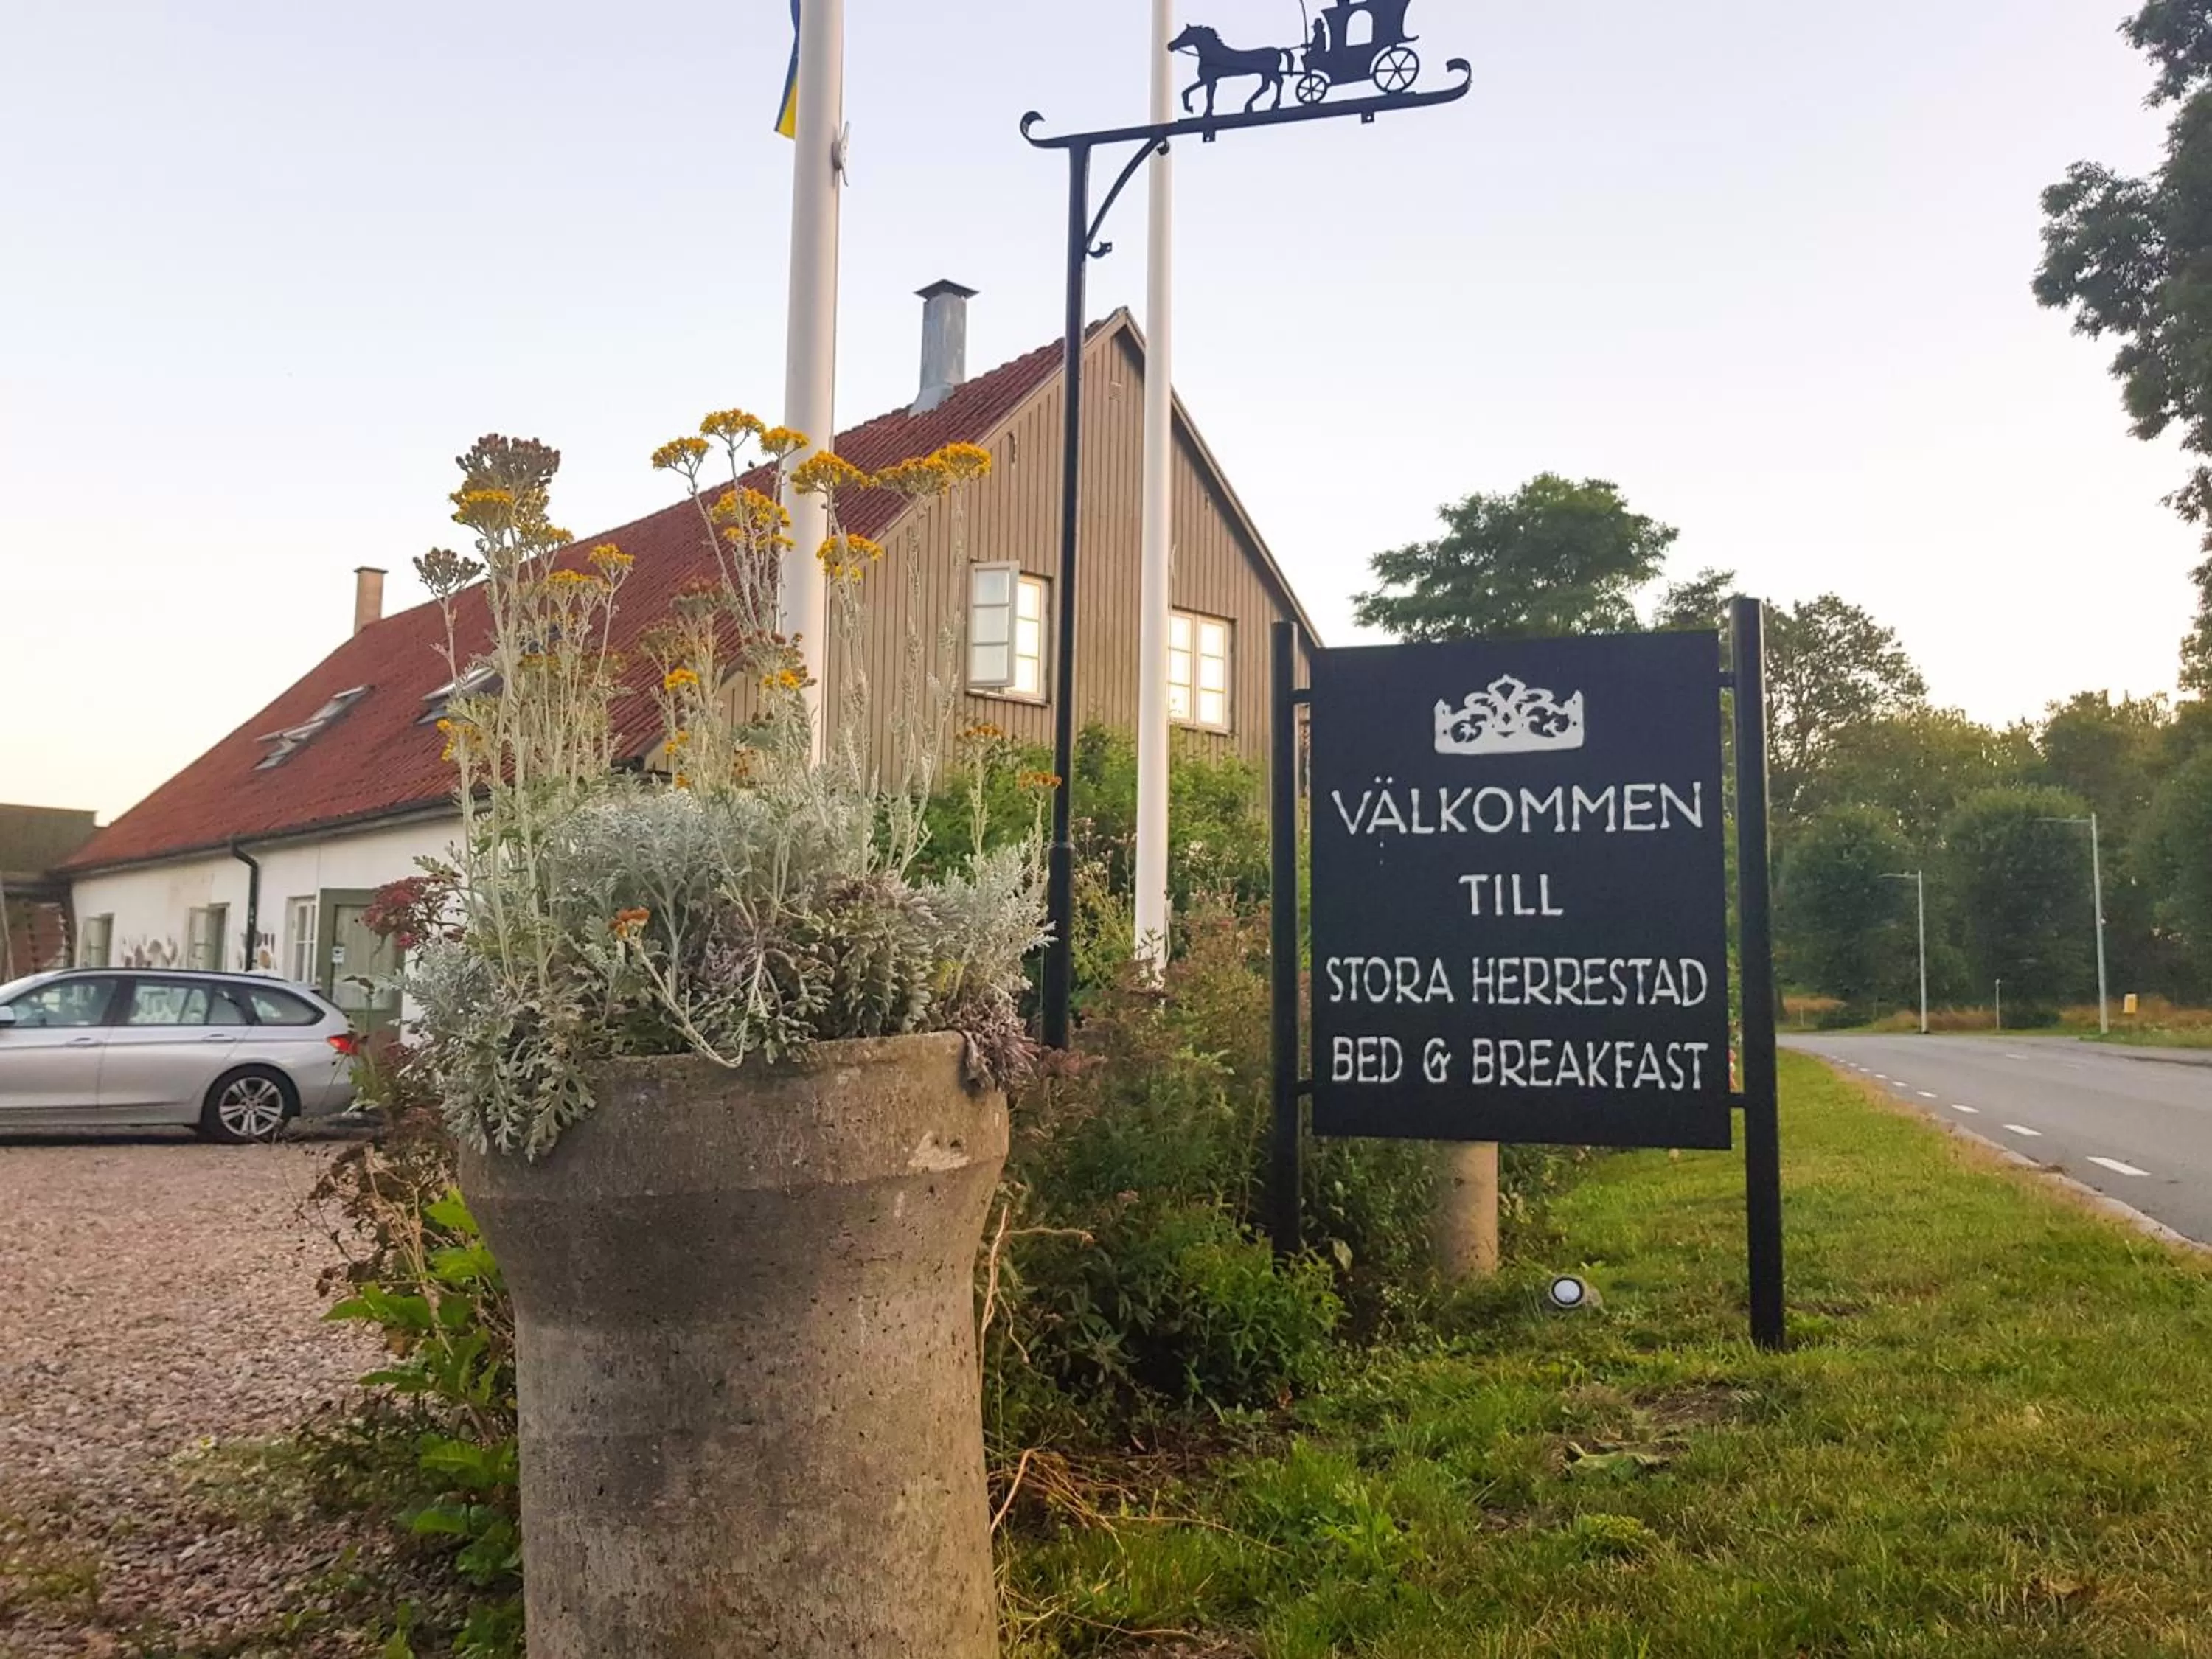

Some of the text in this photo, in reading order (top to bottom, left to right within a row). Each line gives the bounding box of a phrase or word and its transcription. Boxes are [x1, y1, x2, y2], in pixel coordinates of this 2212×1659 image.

[1330, 776, 1703, 835] VÄLKOMMEN
[1458, 874, 1565, 917] TILL
[1326, 956, 1708, 1006] STORA HERRESTAD
[1331, 1036, 1403, 1083] BED
[1472, 1038, 1709, 1091] BREAKFAST
